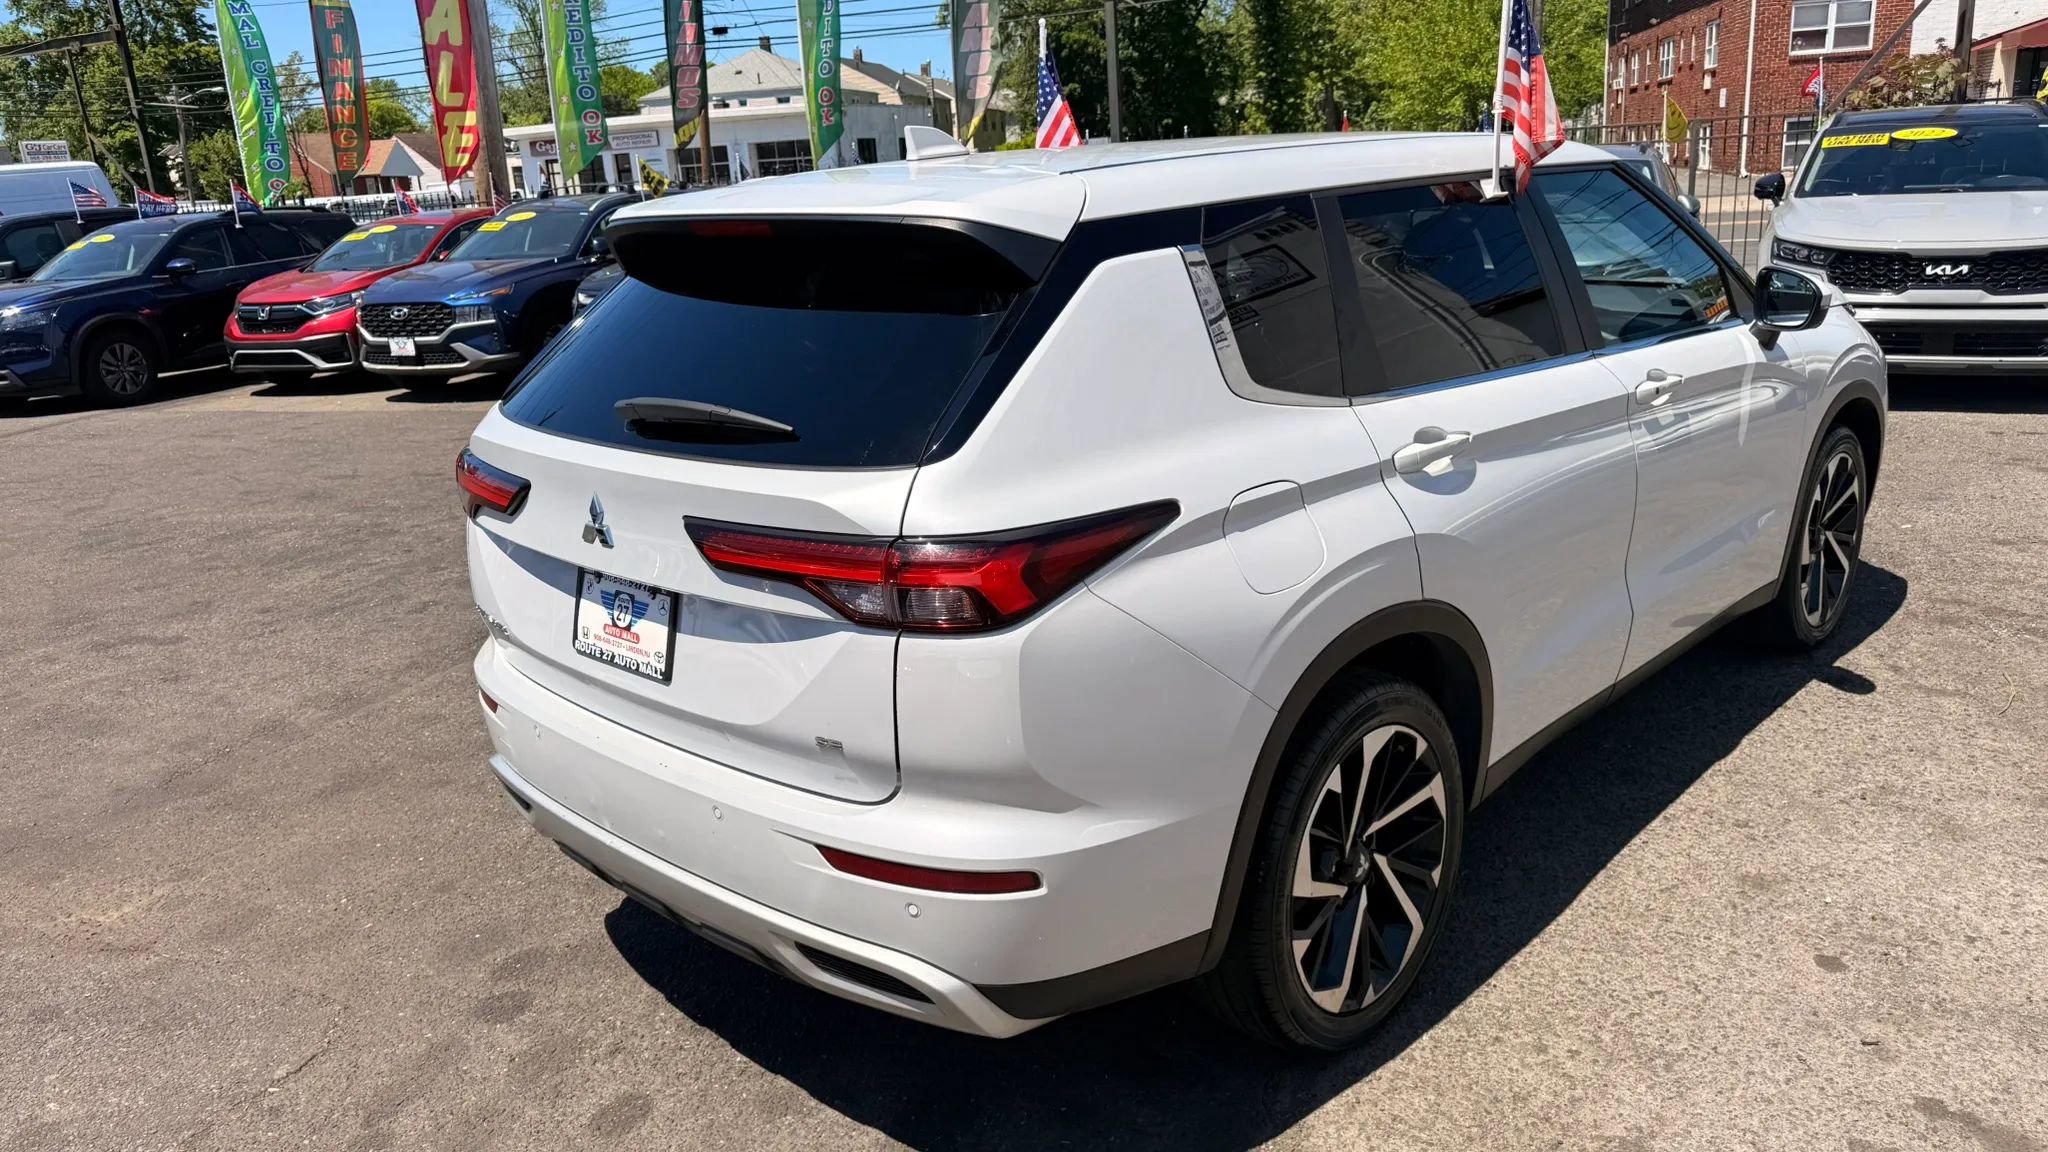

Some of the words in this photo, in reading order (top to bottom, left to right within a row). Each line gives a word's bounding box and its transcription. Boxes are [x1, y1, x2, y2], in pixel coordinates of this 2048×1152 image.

[325, 10, 358, 171] FINANCE
[563, 0, 597, 102] EDITO
[582, 108, 603, 145] OK
[251, 60, 287, 172] CREDITO
[1925, 264, 1969, 276] KIA
[616, 603, 630, 623] 27
[604, 626, 620, 637] AUTO
[621, 629, 638, 643] MALL
[575, 640, 601, 657] ROUTE
[602, 650, 613, 661] 27
[613, 653, 638, 668] AUTO
[638, 661, 664, 680] MALL
